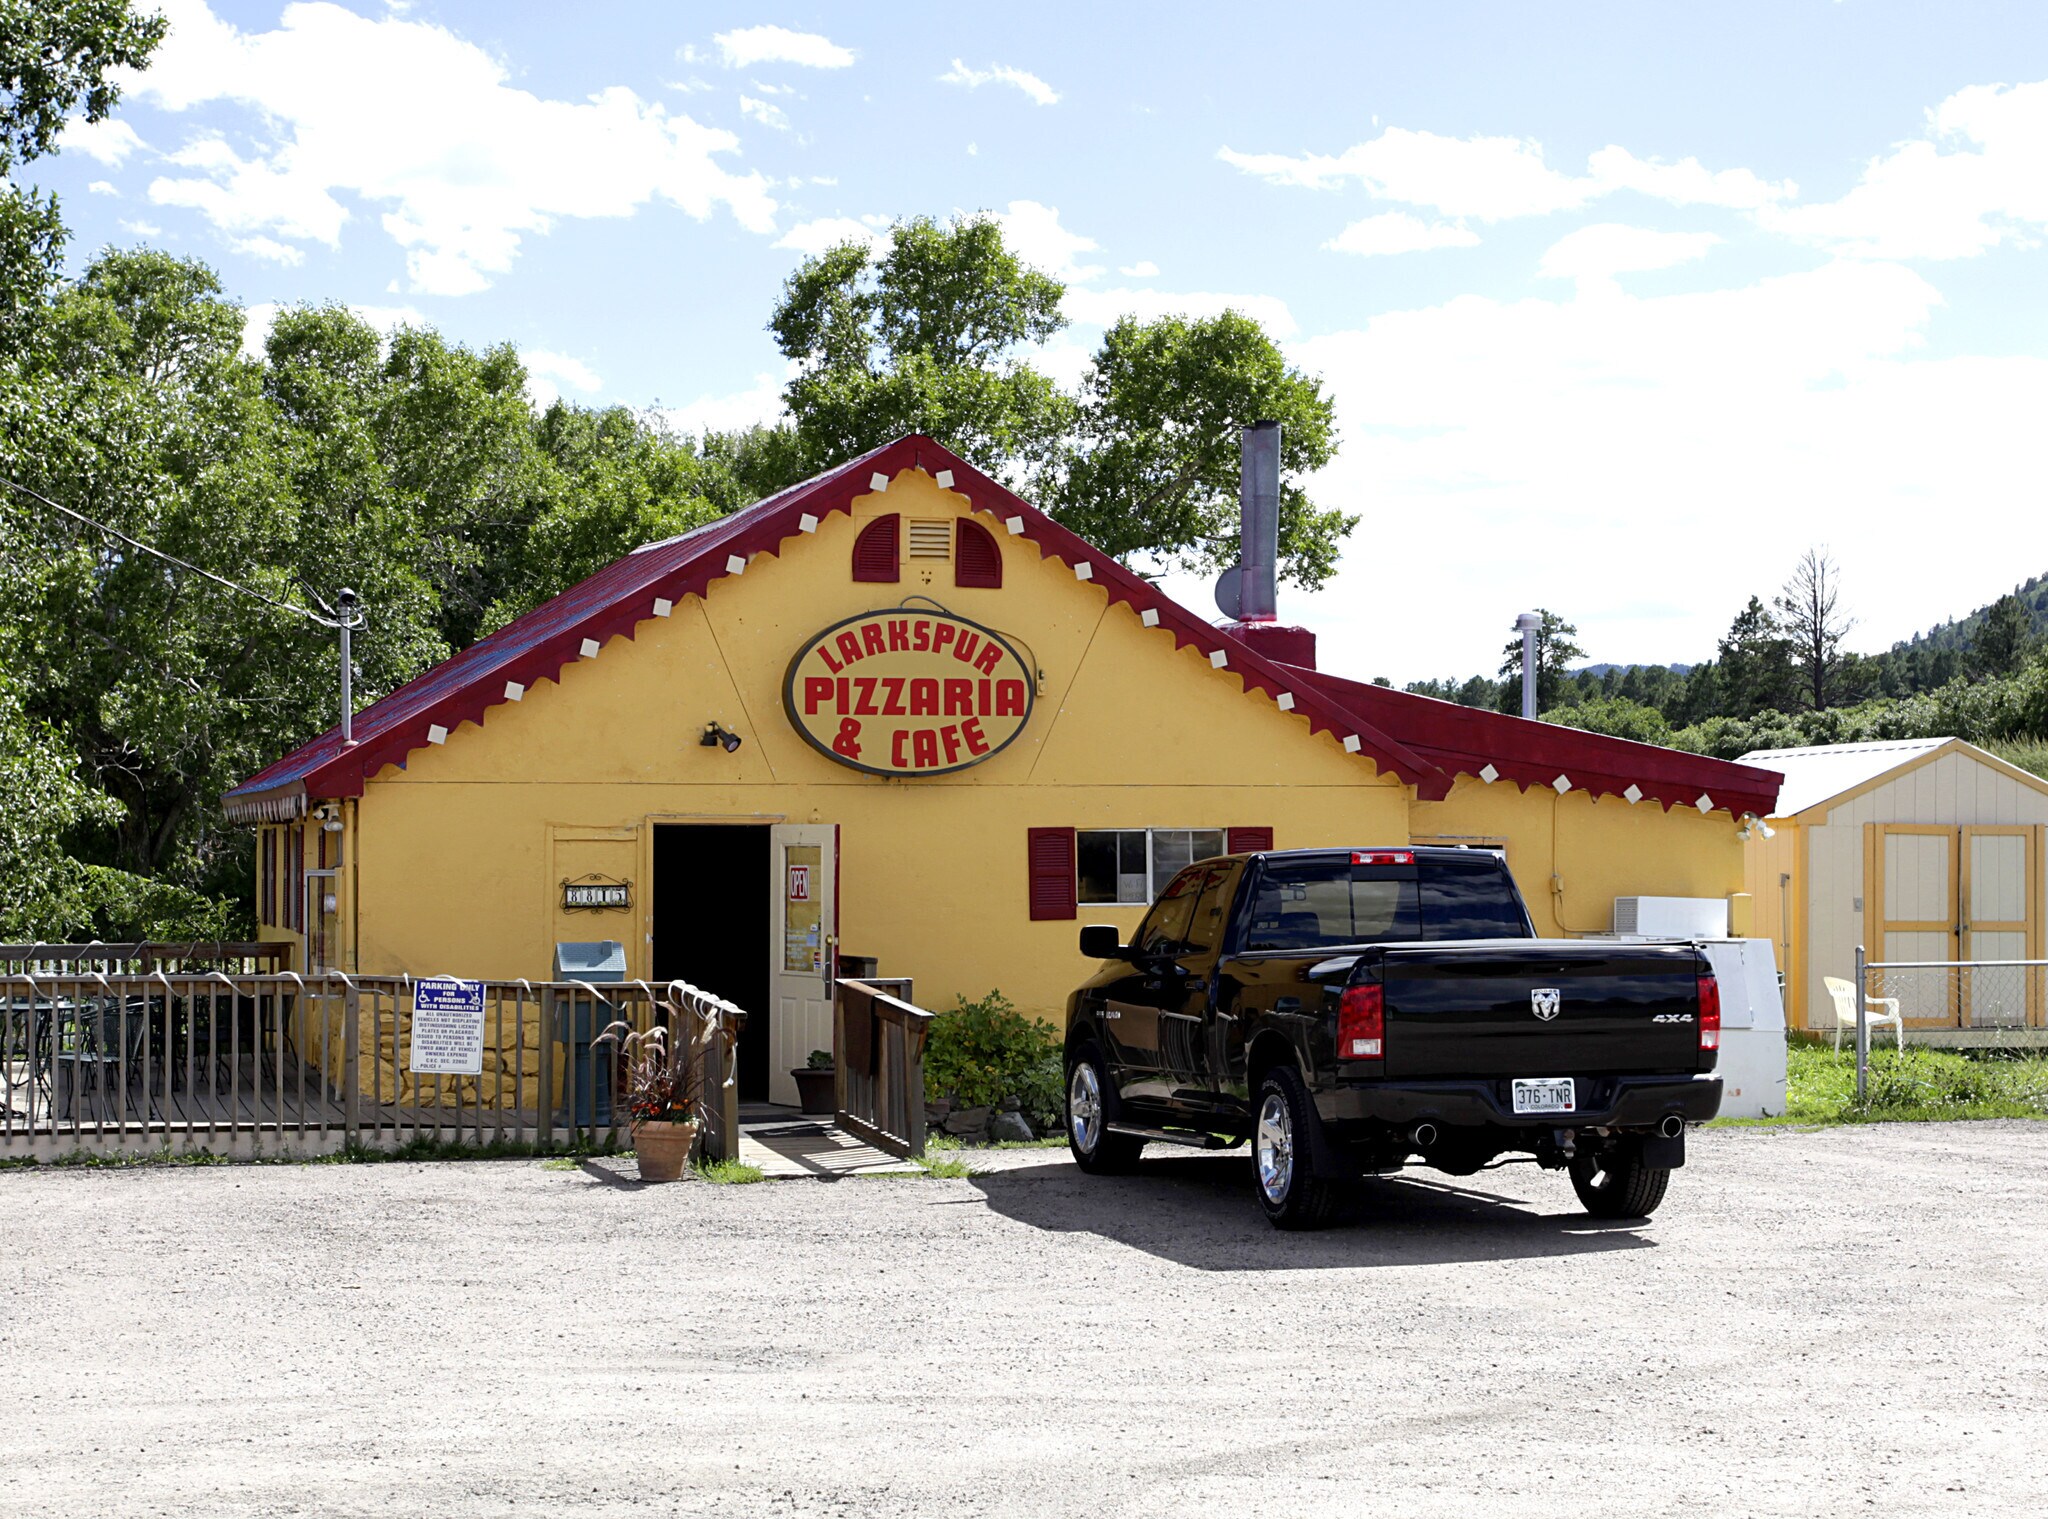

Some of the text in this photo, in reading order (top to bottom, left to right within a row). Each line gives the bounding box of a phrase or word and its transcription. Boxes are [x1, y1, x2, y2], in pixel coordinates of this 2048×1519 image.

[817, 620, 1003, 677] LARKSPUR
[805, 677, 1024, 716] PIZZARIA
[832, 716, 990, 768] & CAFE
[791, 870, 808, 897] OPEN
[420, 982, 457, 991] PARKING
